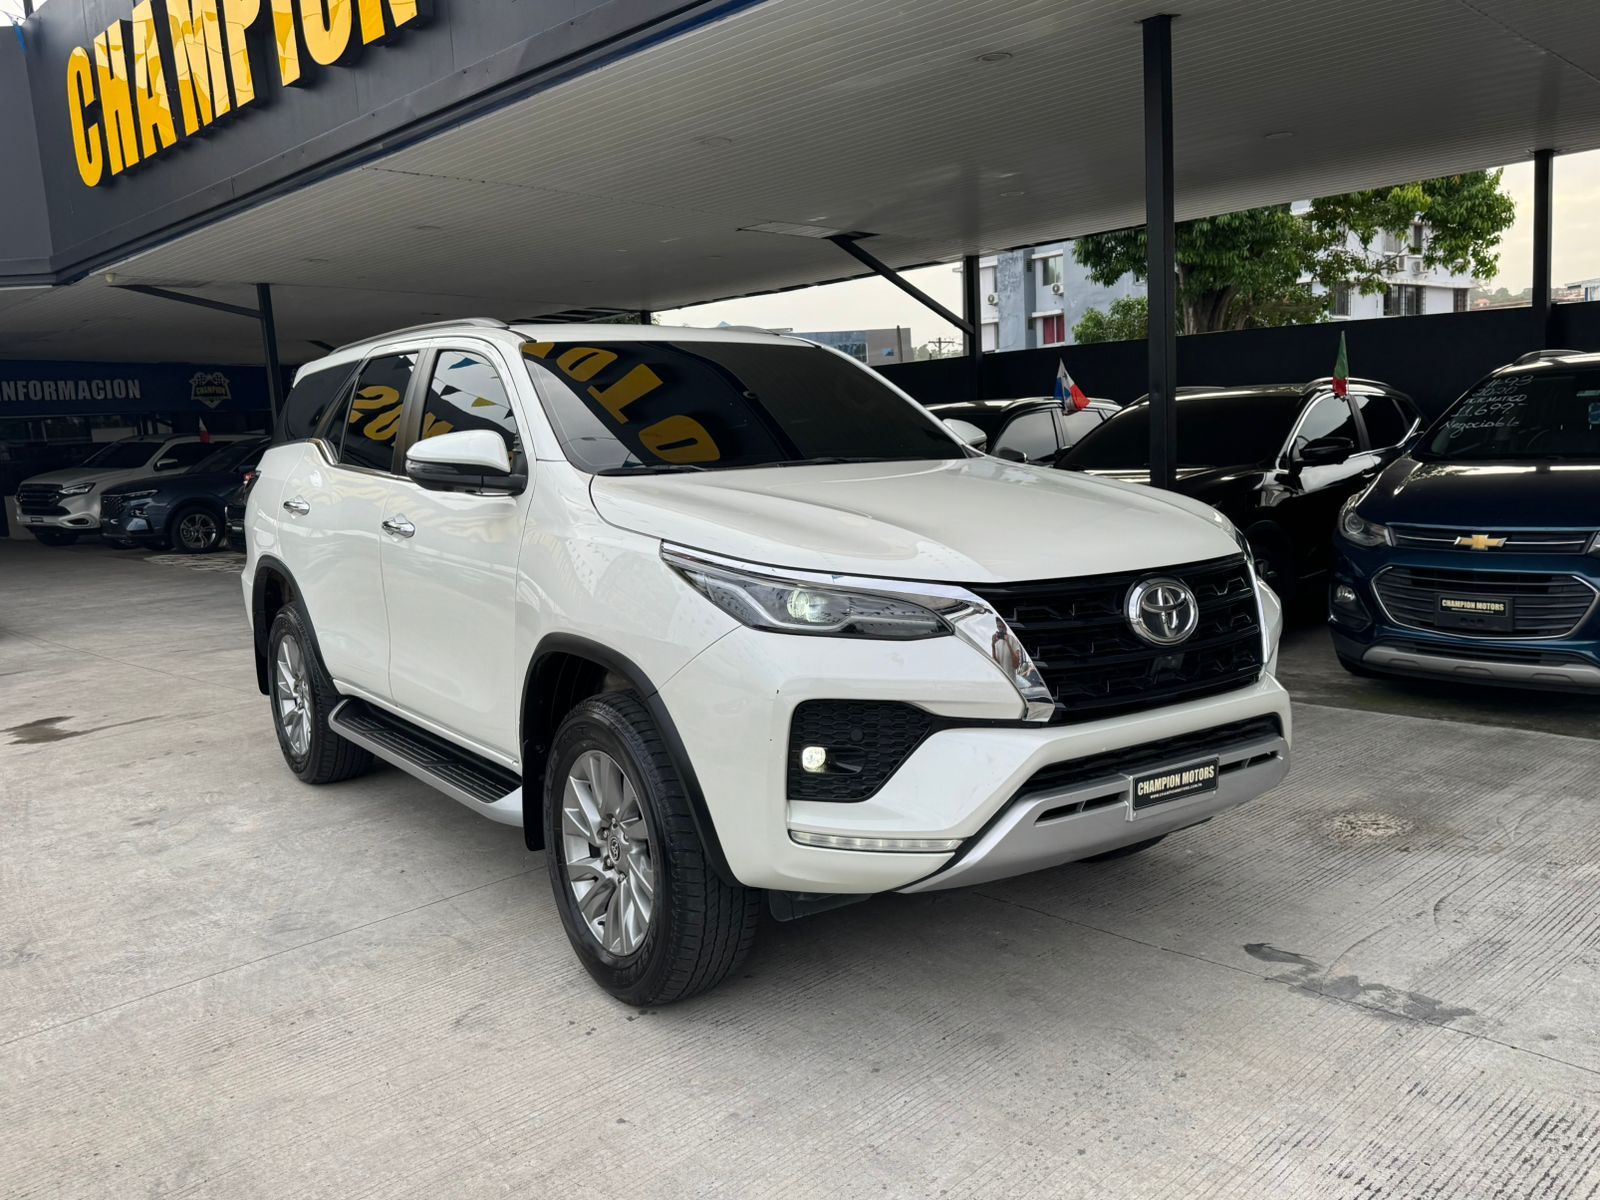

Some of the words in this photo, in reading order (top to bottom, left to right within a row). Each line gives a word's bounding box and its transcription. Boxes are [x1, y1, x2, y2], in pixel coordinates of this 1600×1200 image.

[67, 0, 418, 187] CHAMPI
[0, 379, 141, 401] NFORMACION
[1442, 599, 1475, 609] CHAMPION
[1476, 602, 1504, 611] MOTORS
[1137, 773, 1181, 796] CHAMPION
[1182, 765, 1215, 785] MOTORS
